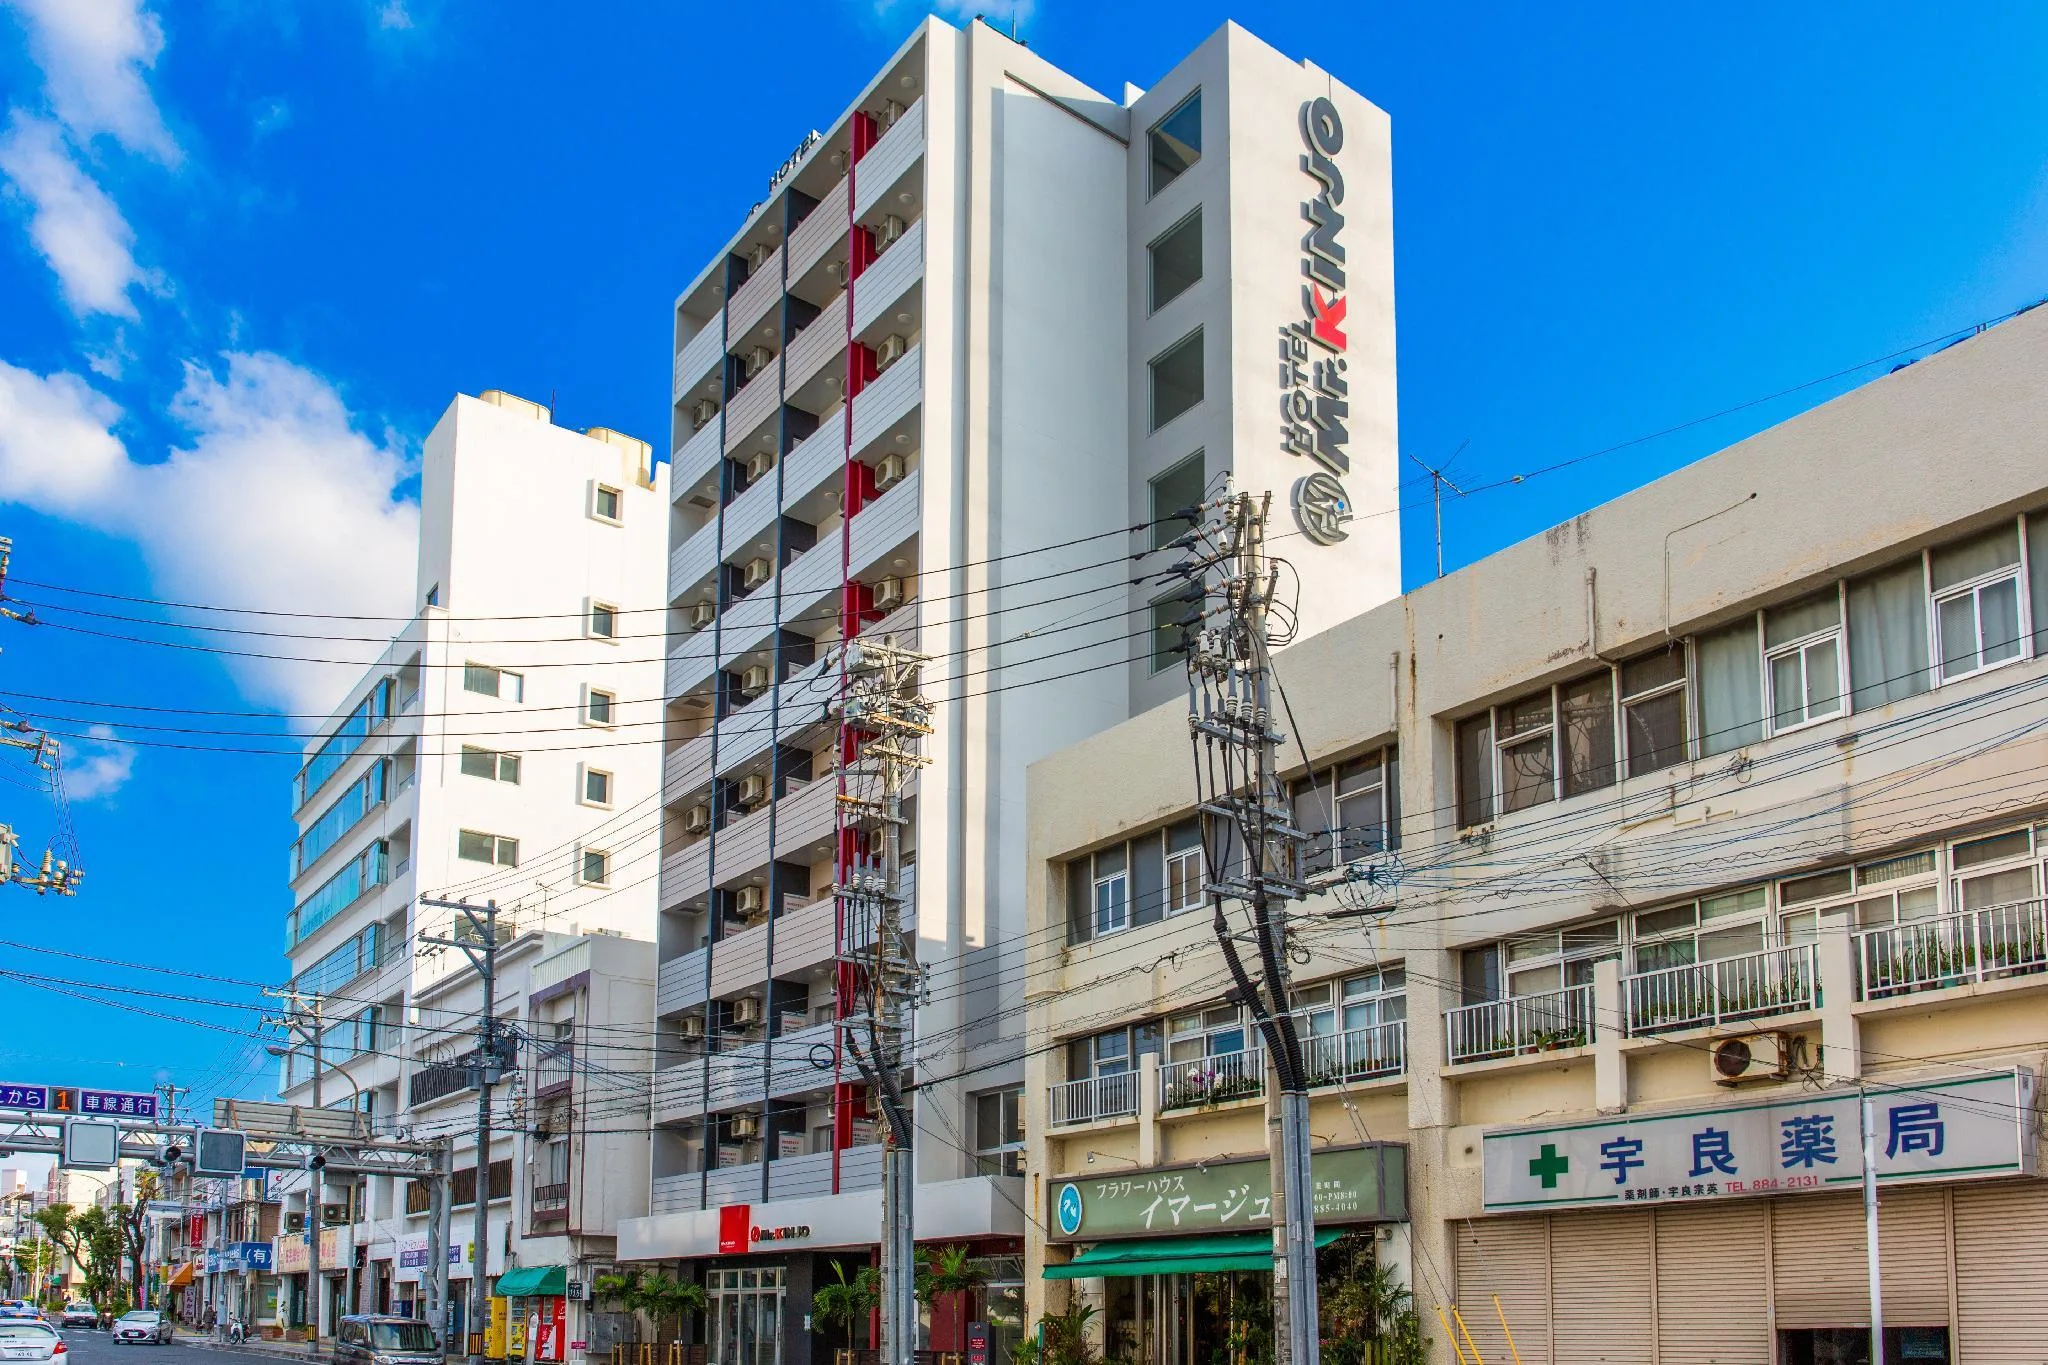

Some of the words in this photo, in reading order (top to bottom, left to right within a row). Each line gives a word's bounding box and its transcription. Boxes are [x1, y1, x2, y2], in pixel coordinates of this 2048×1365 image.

[1287, 320, 1311, 456] HOTEL
[0, 1090, 41, 1106] から
[57, 1091, 70, 1111] 1
[86, 1095, 151, 1114] 車線通行
[1600, 1103, 1945, 1185] 宇良薬局
[1096, 1175, 1185, 1200] フラワーハウス
[1139, 1184, 1270, 1230] イマージュ
